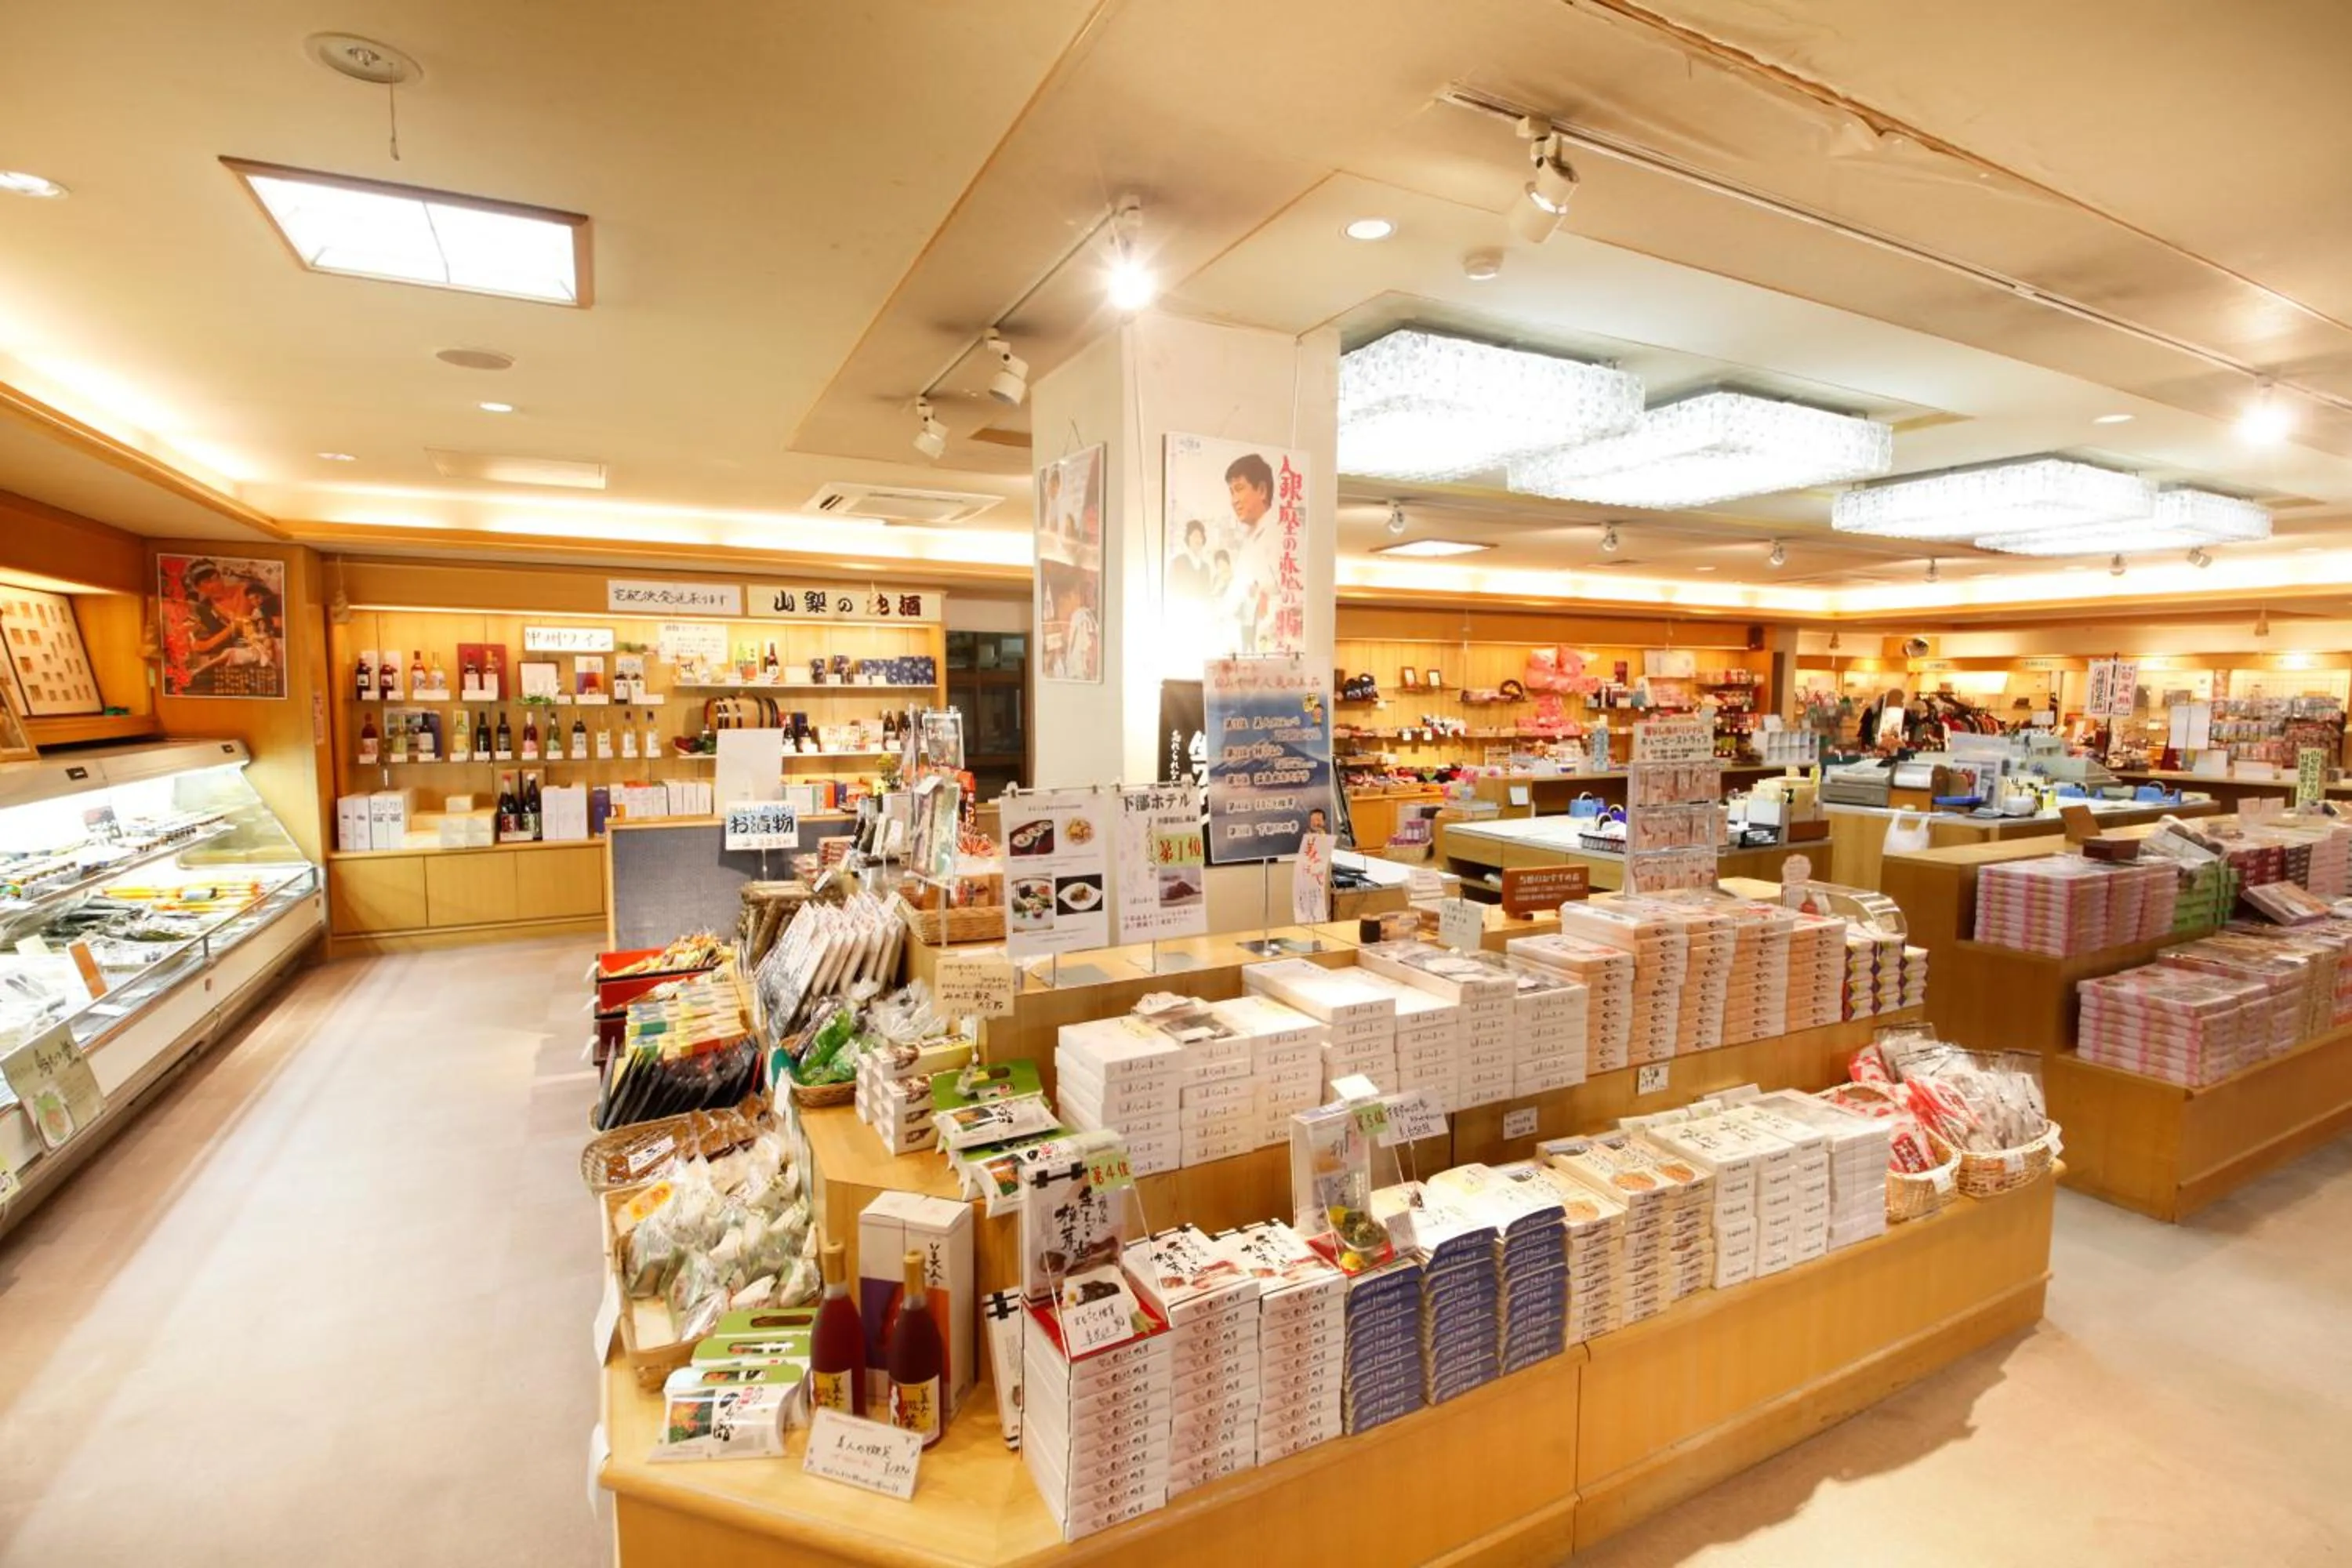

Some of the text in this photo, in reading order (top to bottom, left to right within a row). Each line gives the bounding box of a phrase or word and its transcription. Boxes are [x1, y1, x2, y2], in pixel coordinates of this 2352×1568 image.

[1123, 792, 1191, 812] 下部ホテル
[1159, 835, 1203, 864] 第1位
[1091, 1161, 1131, 1186] 第4位
